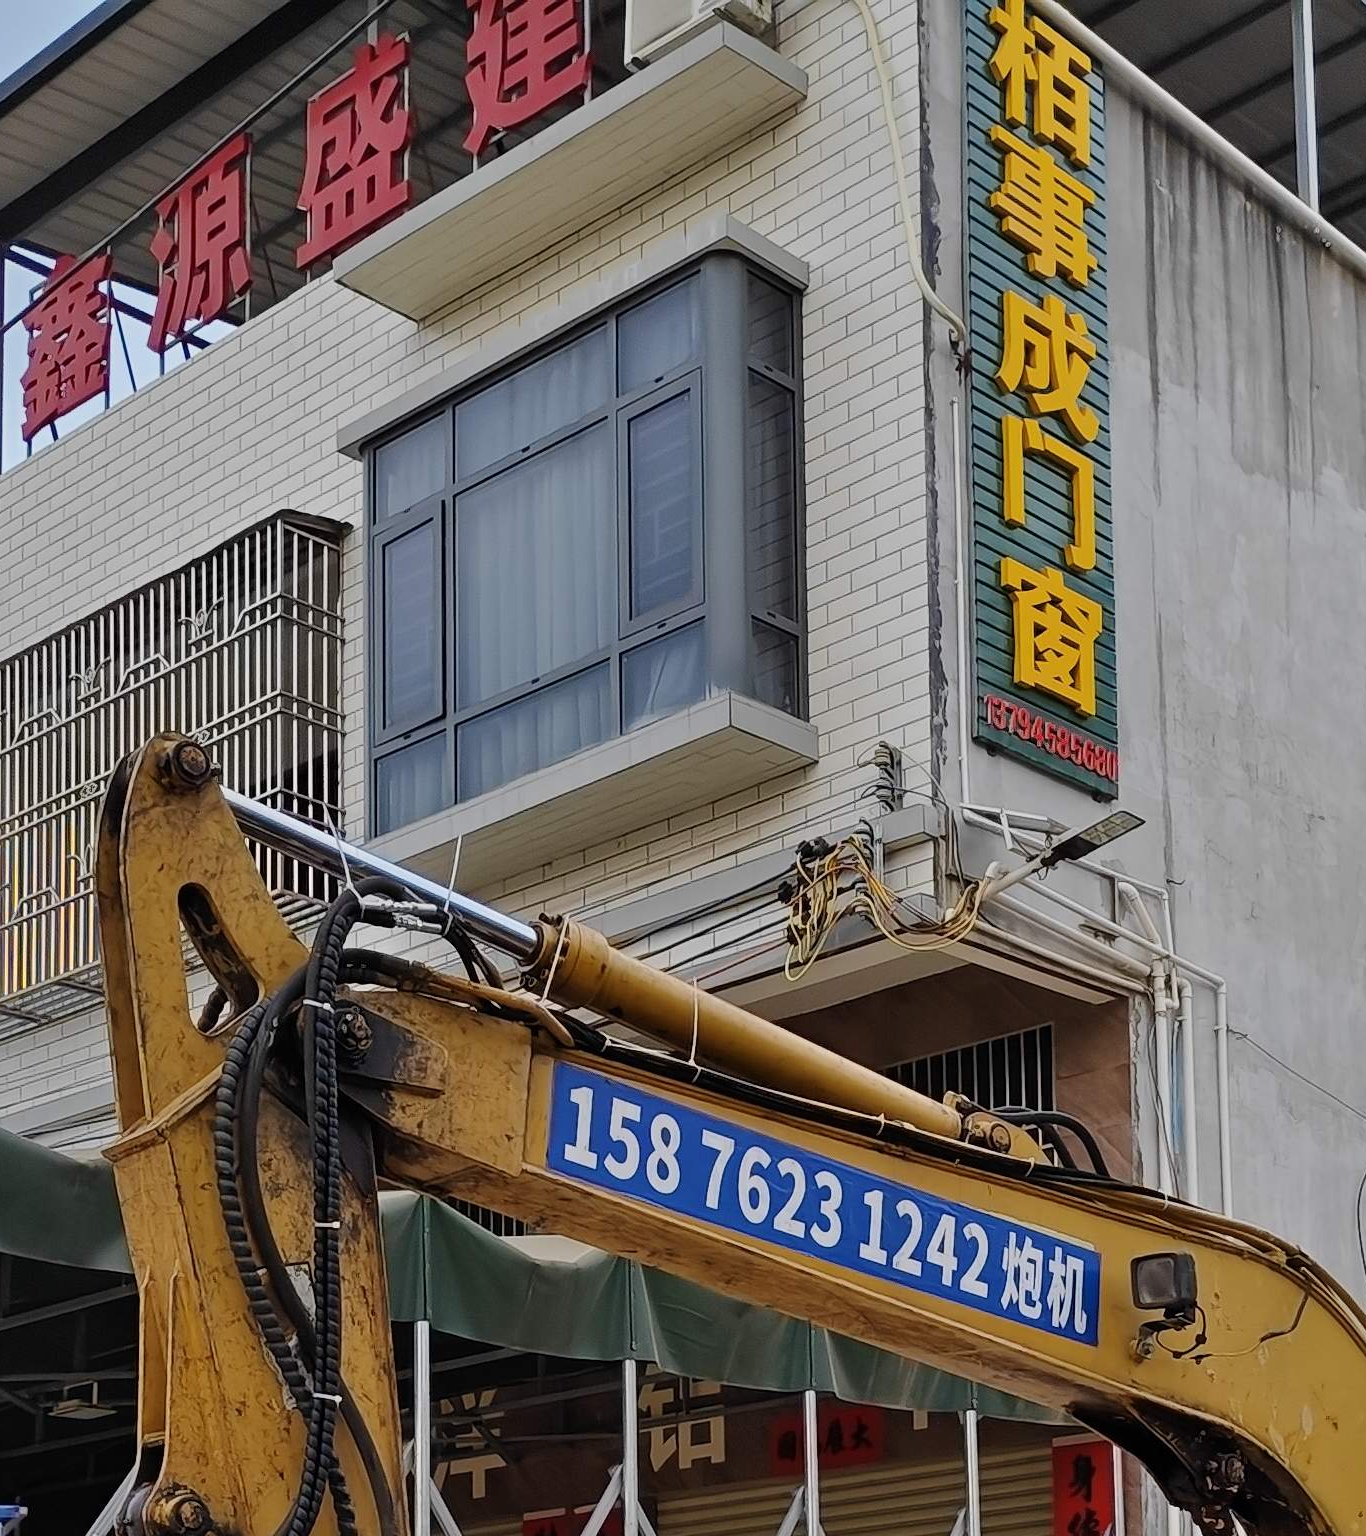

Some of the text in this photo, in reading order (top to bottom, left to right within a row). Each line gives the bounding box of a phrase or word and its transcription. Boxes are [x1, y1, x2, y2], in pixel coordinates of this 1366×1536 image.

[985, 694, 1118, 781] 13794585680
[562, 1085, 682, 1195] 158
[700, 1129, 843, 1248] 7623
